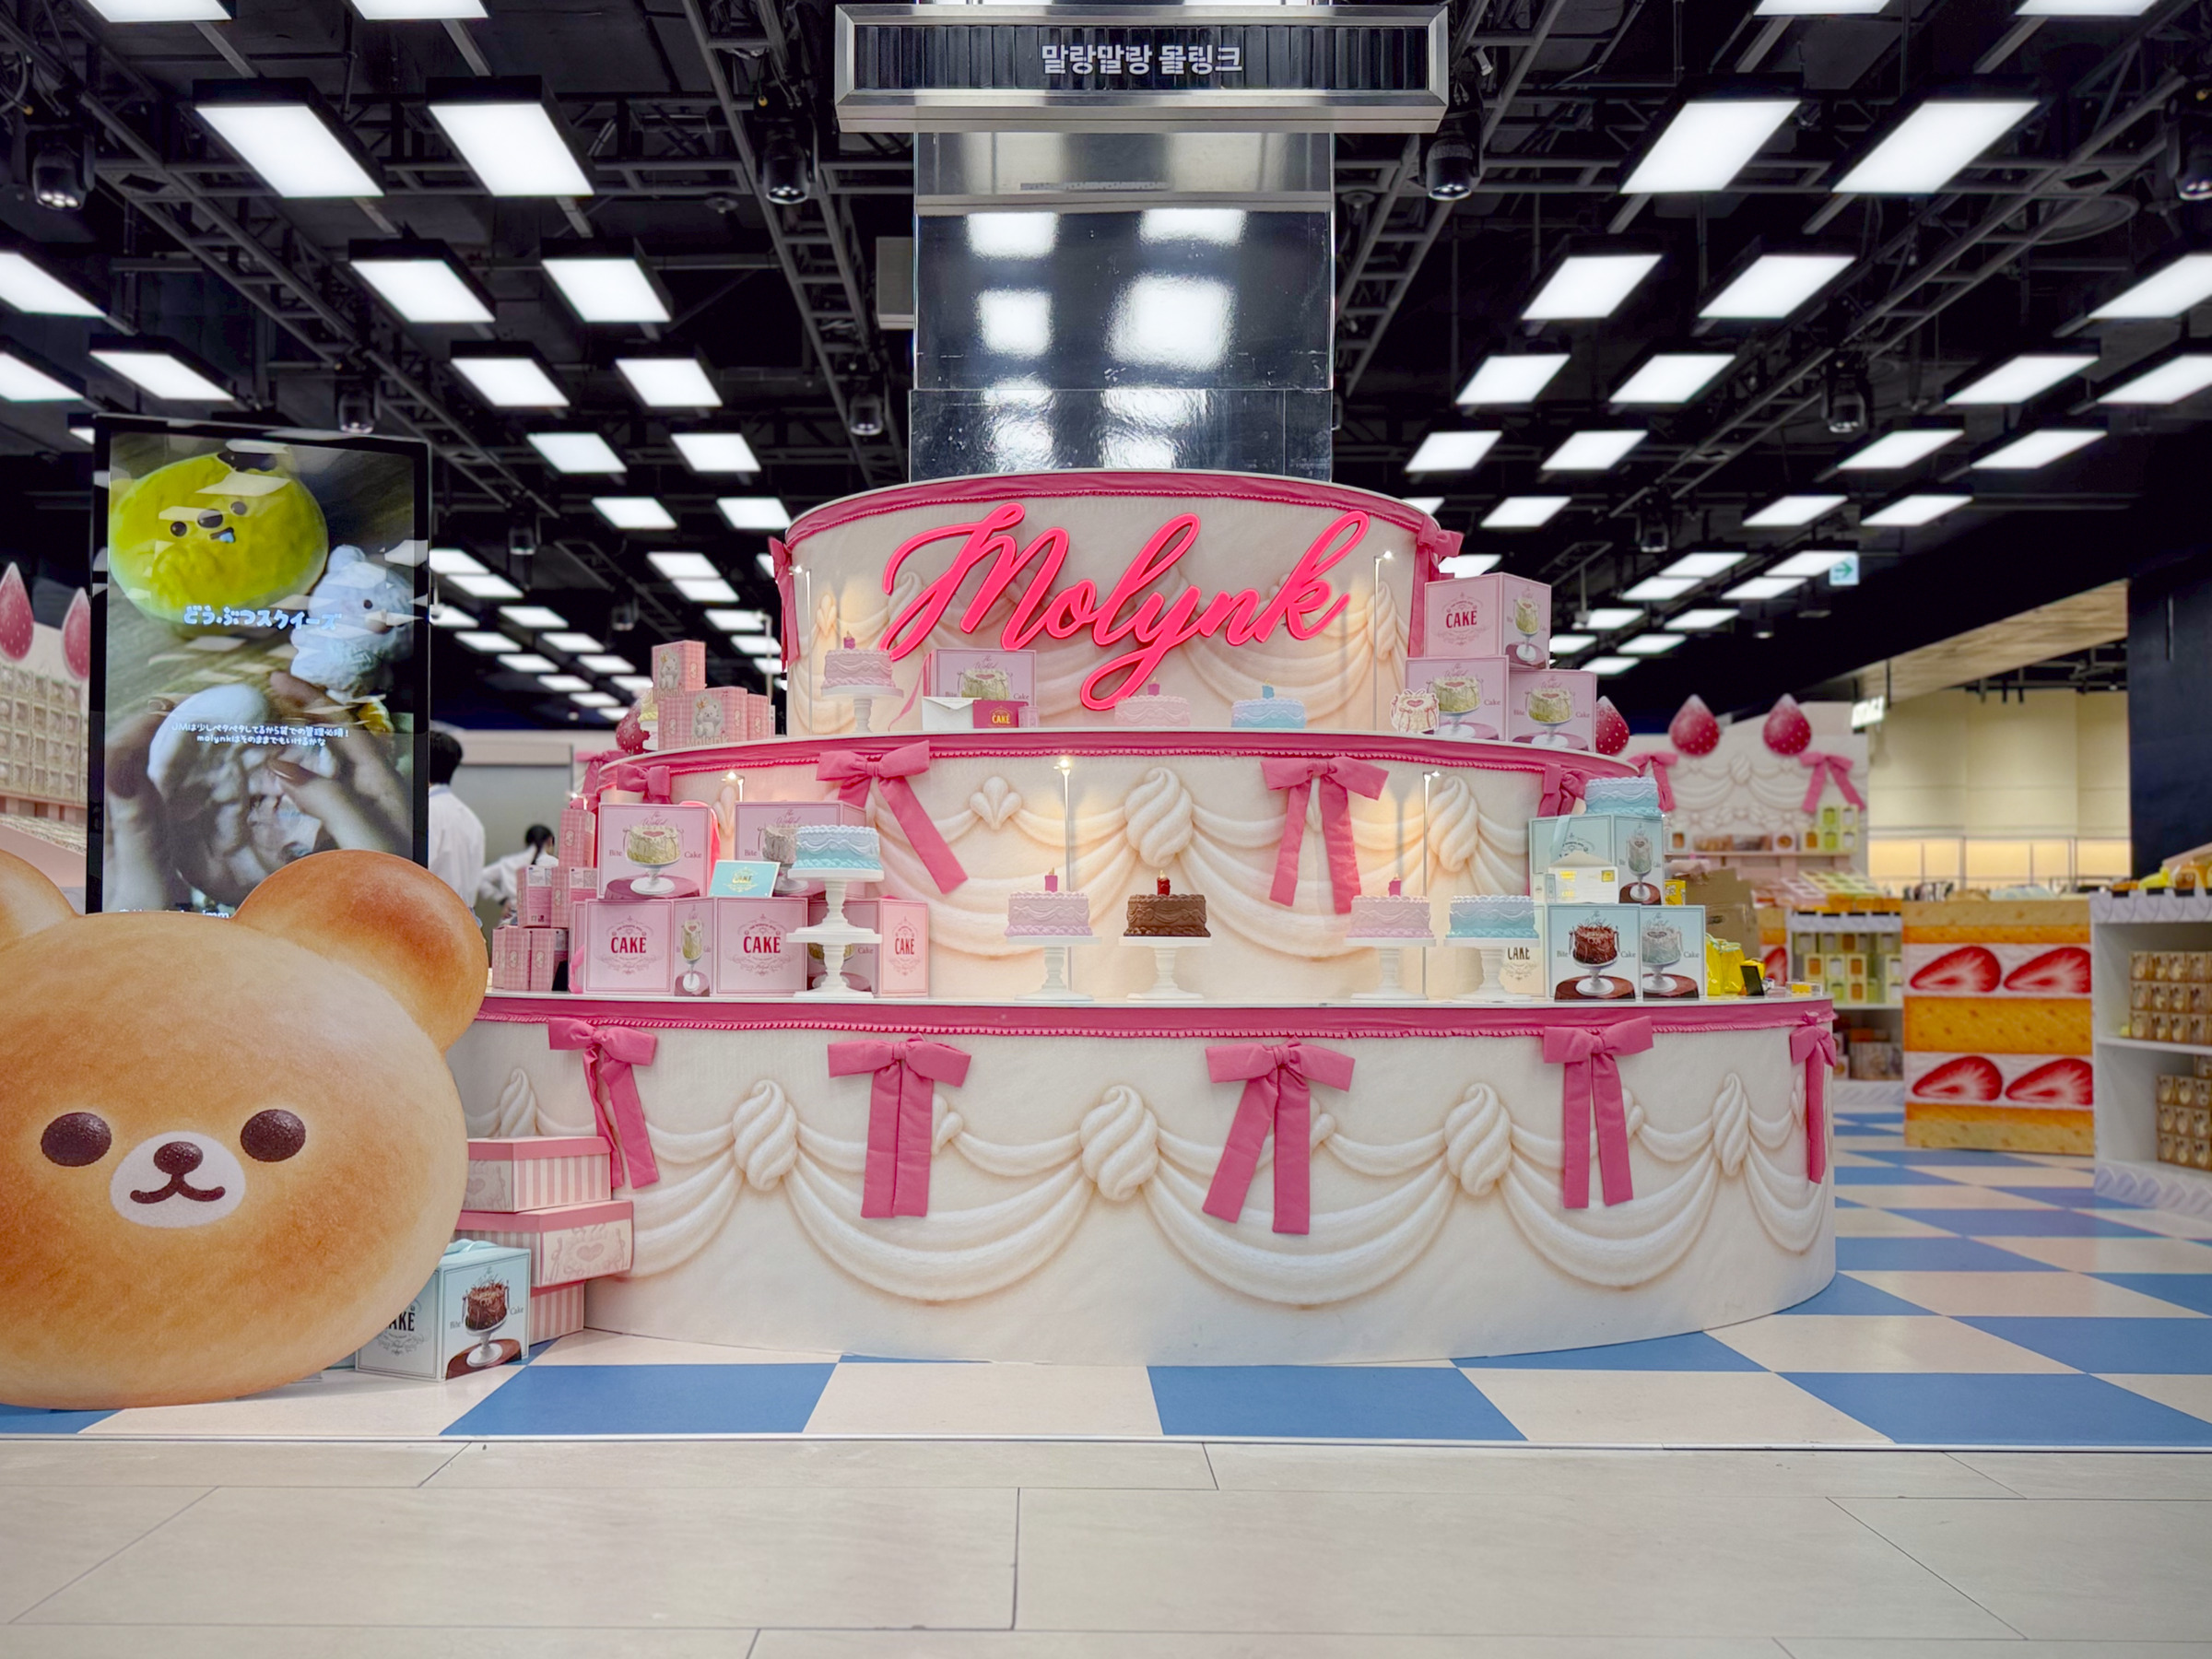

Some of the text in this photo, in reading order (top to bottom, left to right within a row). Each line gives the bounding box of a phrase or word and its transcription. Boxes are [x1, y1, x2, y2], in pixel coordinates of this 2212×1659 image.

[1041, 44, 1242, 75] 말랑말랑 몰링크
[880, 502, 1371, 711] Molynk
[183, 605, 342, 630] どうぶつスクイーズ
[1446, 610, 1477, 629] CAKE
[992, 713, 1011, 724] CAKE
[611, 936, 647, 954] CAKE
[743, 935, 781, 954] CAKE
[857, 947, 874, 955] Cake
[895, 937, 915, 955] CAKE
[510, 1306, 524, 1316] Cake
[388, 1311, 415, 1332] AKE
